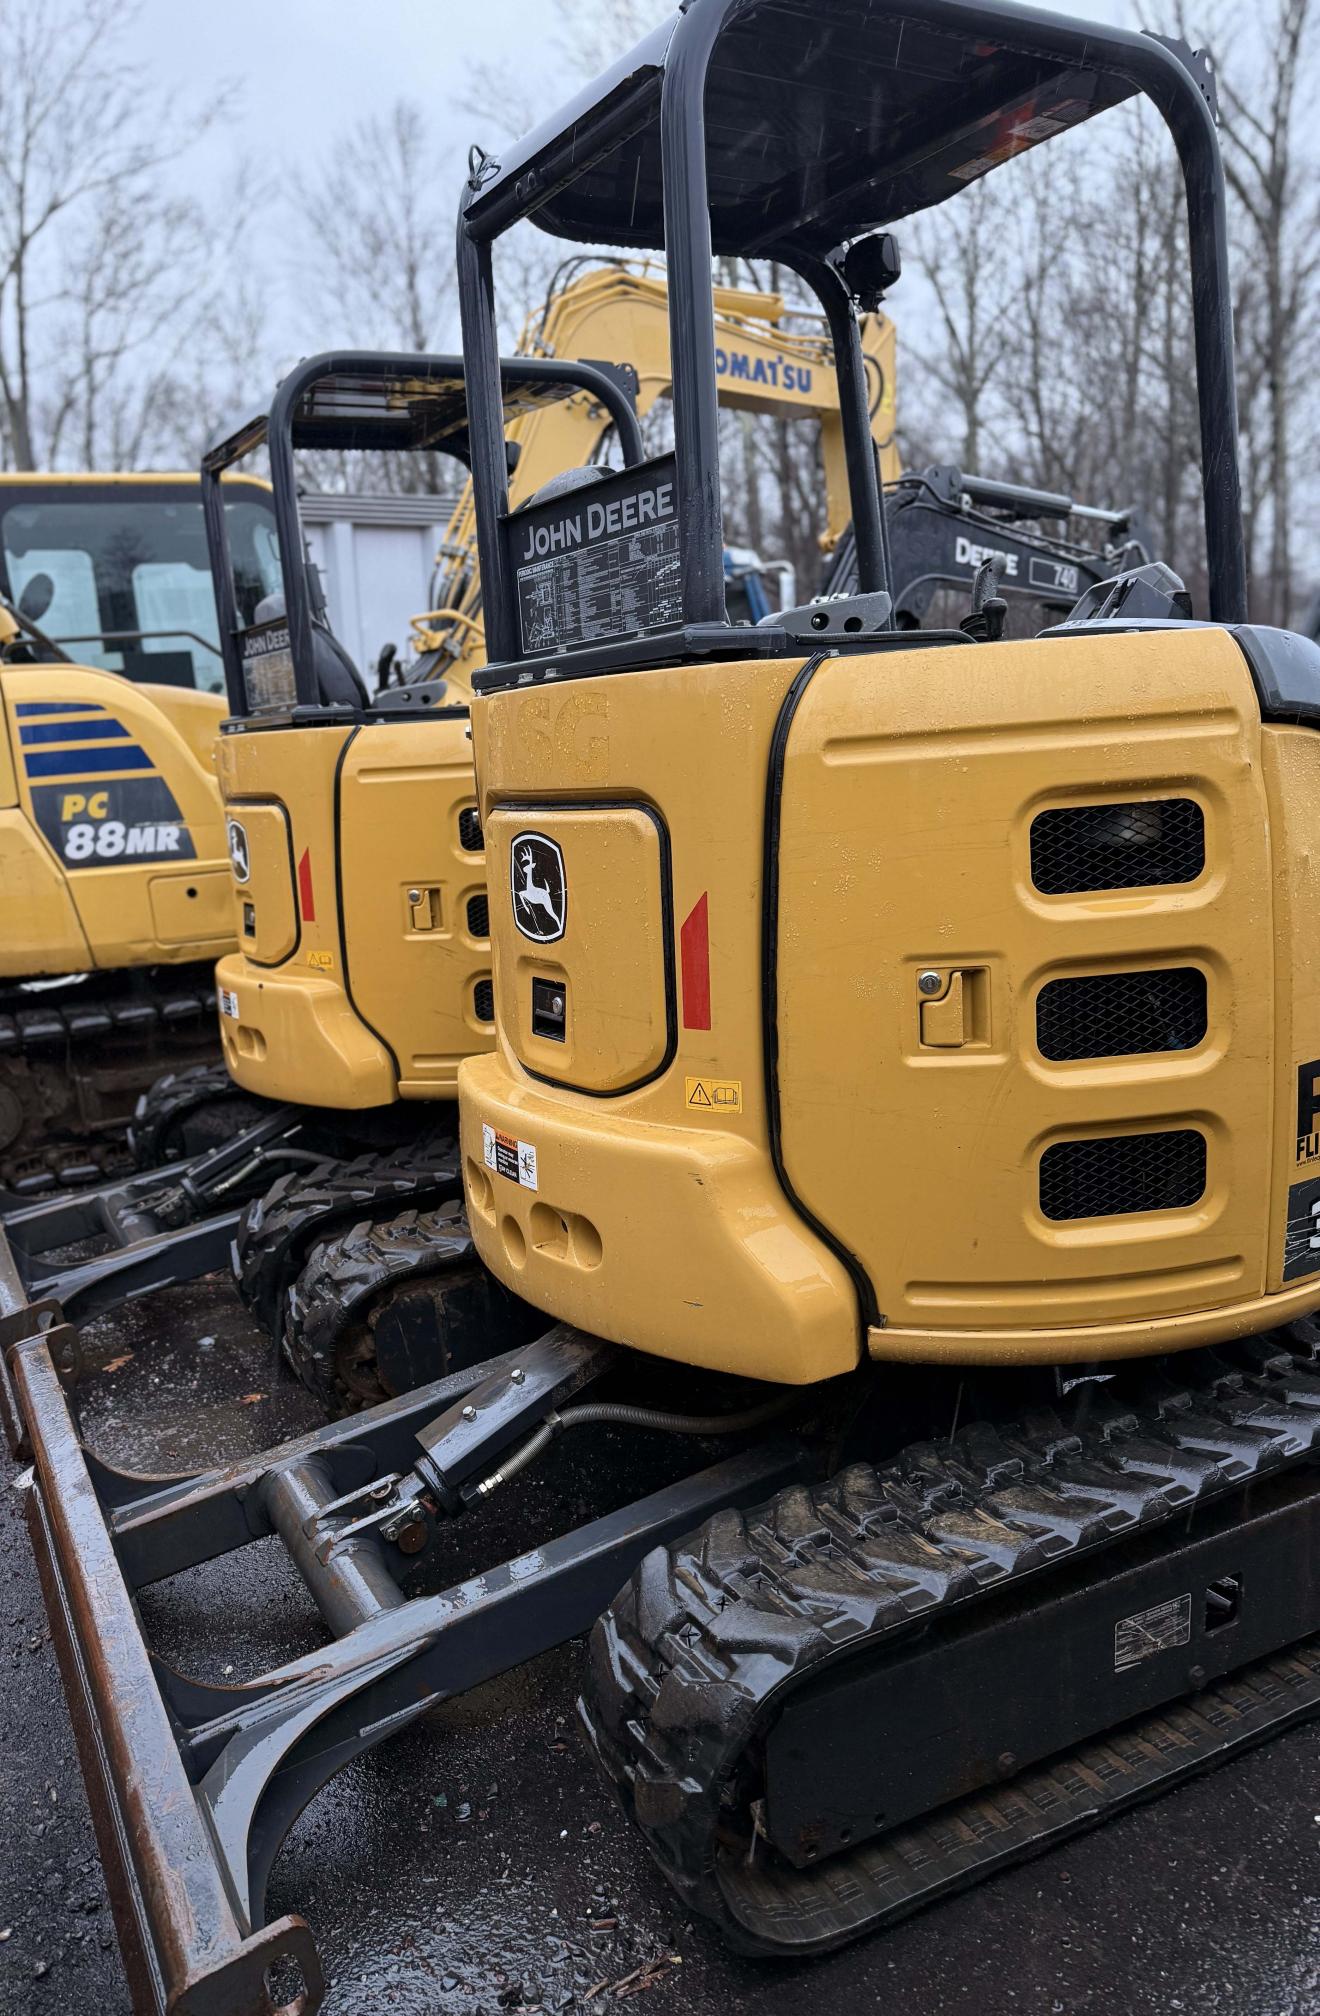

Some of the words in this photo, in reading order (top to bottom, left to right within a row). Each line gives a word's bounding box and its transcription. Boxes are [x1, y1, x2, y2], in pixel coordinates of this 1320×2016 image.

[716, 348, 812, 394] OMATSU
[523, 515, 583, 561] JOHN
[586, 483, 674, 540] DEERE
[955, 536, 1019, 577] DEEE
[244, 635, 267, 657] JOHN
[266, 628, 290, 650] DEER
[61, 792, 109, 822] PC
[64, 821, 180, 860] 88MR
